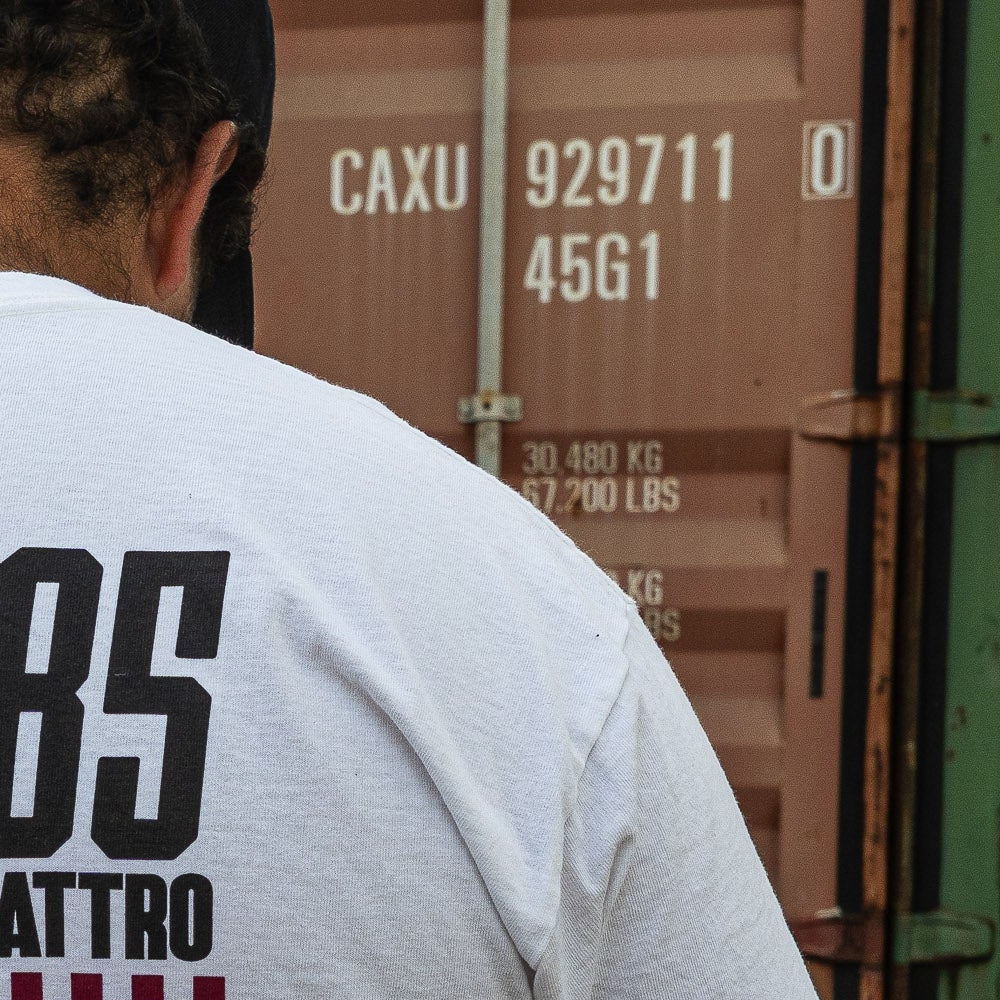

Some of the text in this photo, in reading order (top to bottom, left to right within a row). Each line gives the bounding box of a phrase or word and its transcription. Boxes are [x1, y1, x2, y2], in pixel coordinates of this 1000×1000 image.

[329, 122, 848, 216] CAXU 929711 0
[523, 230, 660, 303] 45G1
[627, 440, 664, 475] KG
[625, 475, 681, 513] LBS
[627, 569, 664, 606] KG
